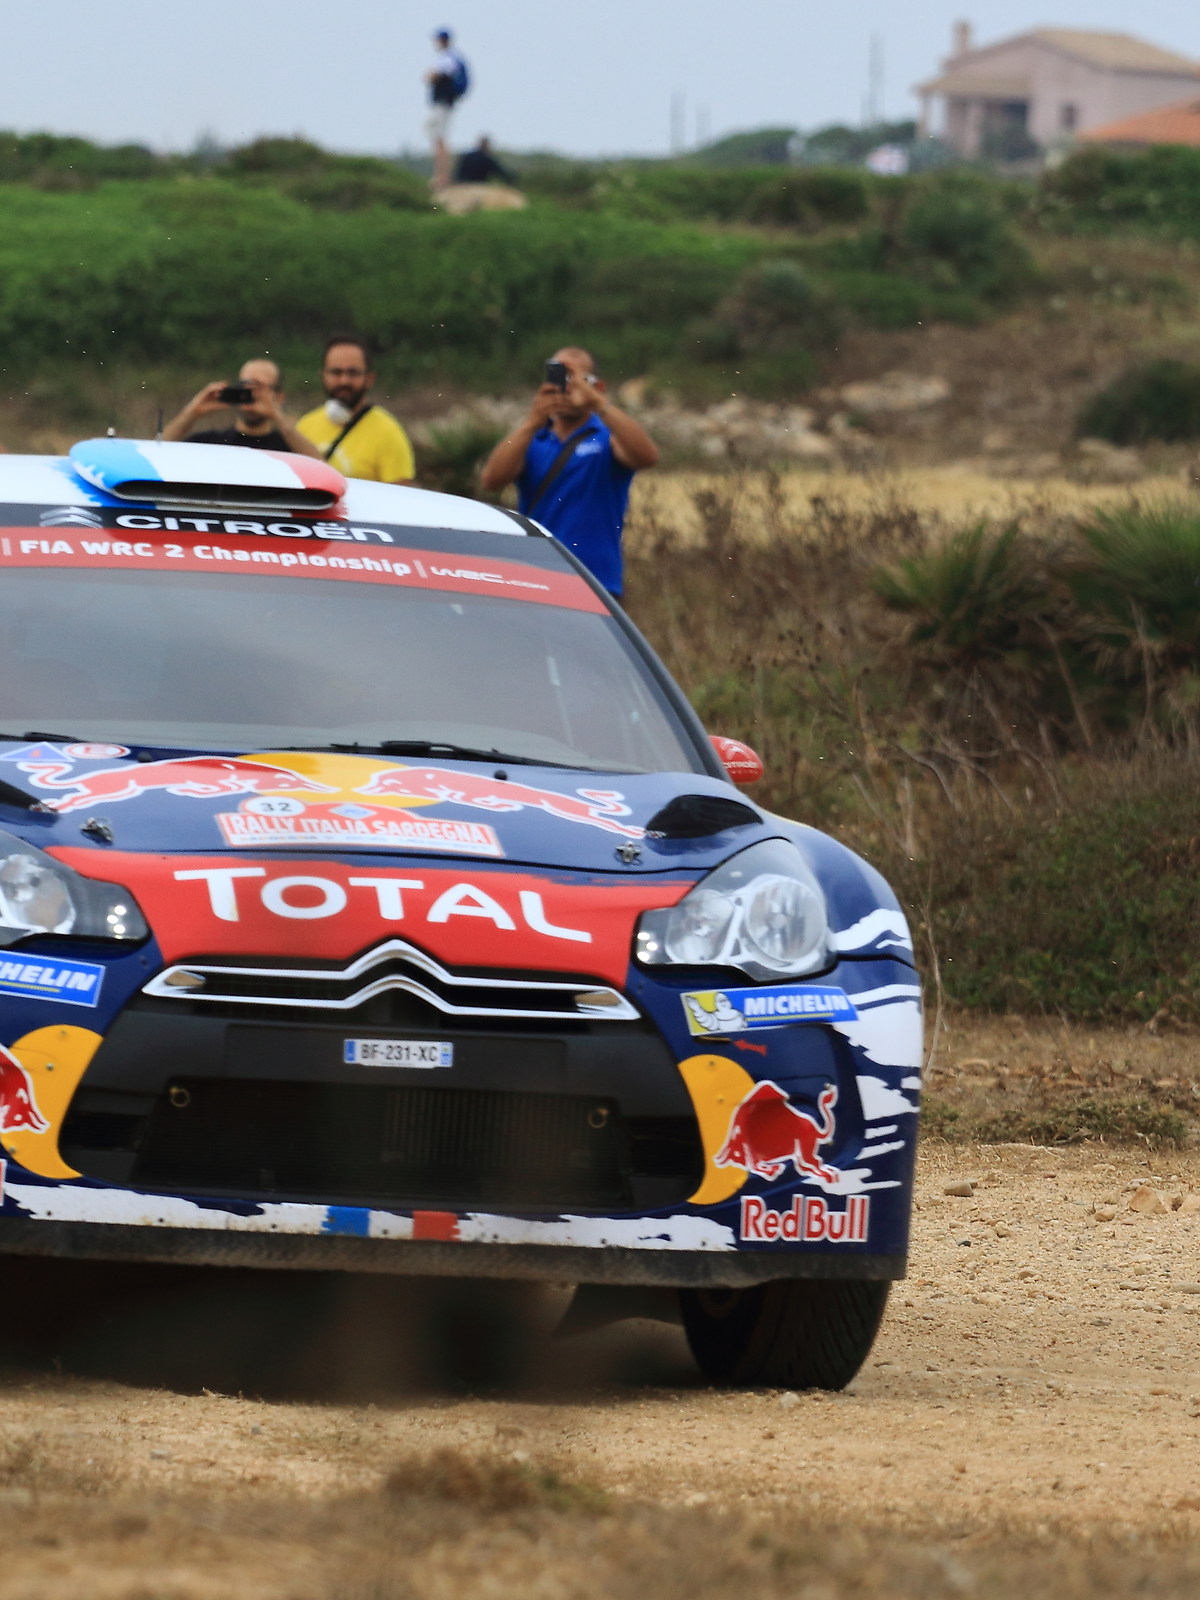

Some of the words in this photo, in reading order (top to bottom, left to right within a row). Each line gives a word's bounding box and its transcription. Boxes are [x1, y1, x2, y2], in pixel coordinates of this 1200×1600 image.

[19, 540, 74, 554] FIA
[80, 541, 154, 557] WRC
[164, 543, 185, 558] 2
[193, 545, 412, 577] Championship
[260, 802, 293, 812] 32
[232, 816, 300, 834] RALLY
[300, 818, 372, 835] ITALIA
[373, 820, 488, 844] SARDEGNA
[174, 867, 592, 943] TOTAL
[744, 994, 849, 1016] MICHELIN
[361, 1044, 438, 1062] BF-231-XC
[742, 1194, 803, 1241] Red
[805, 1195, 869, 1242] Bull
